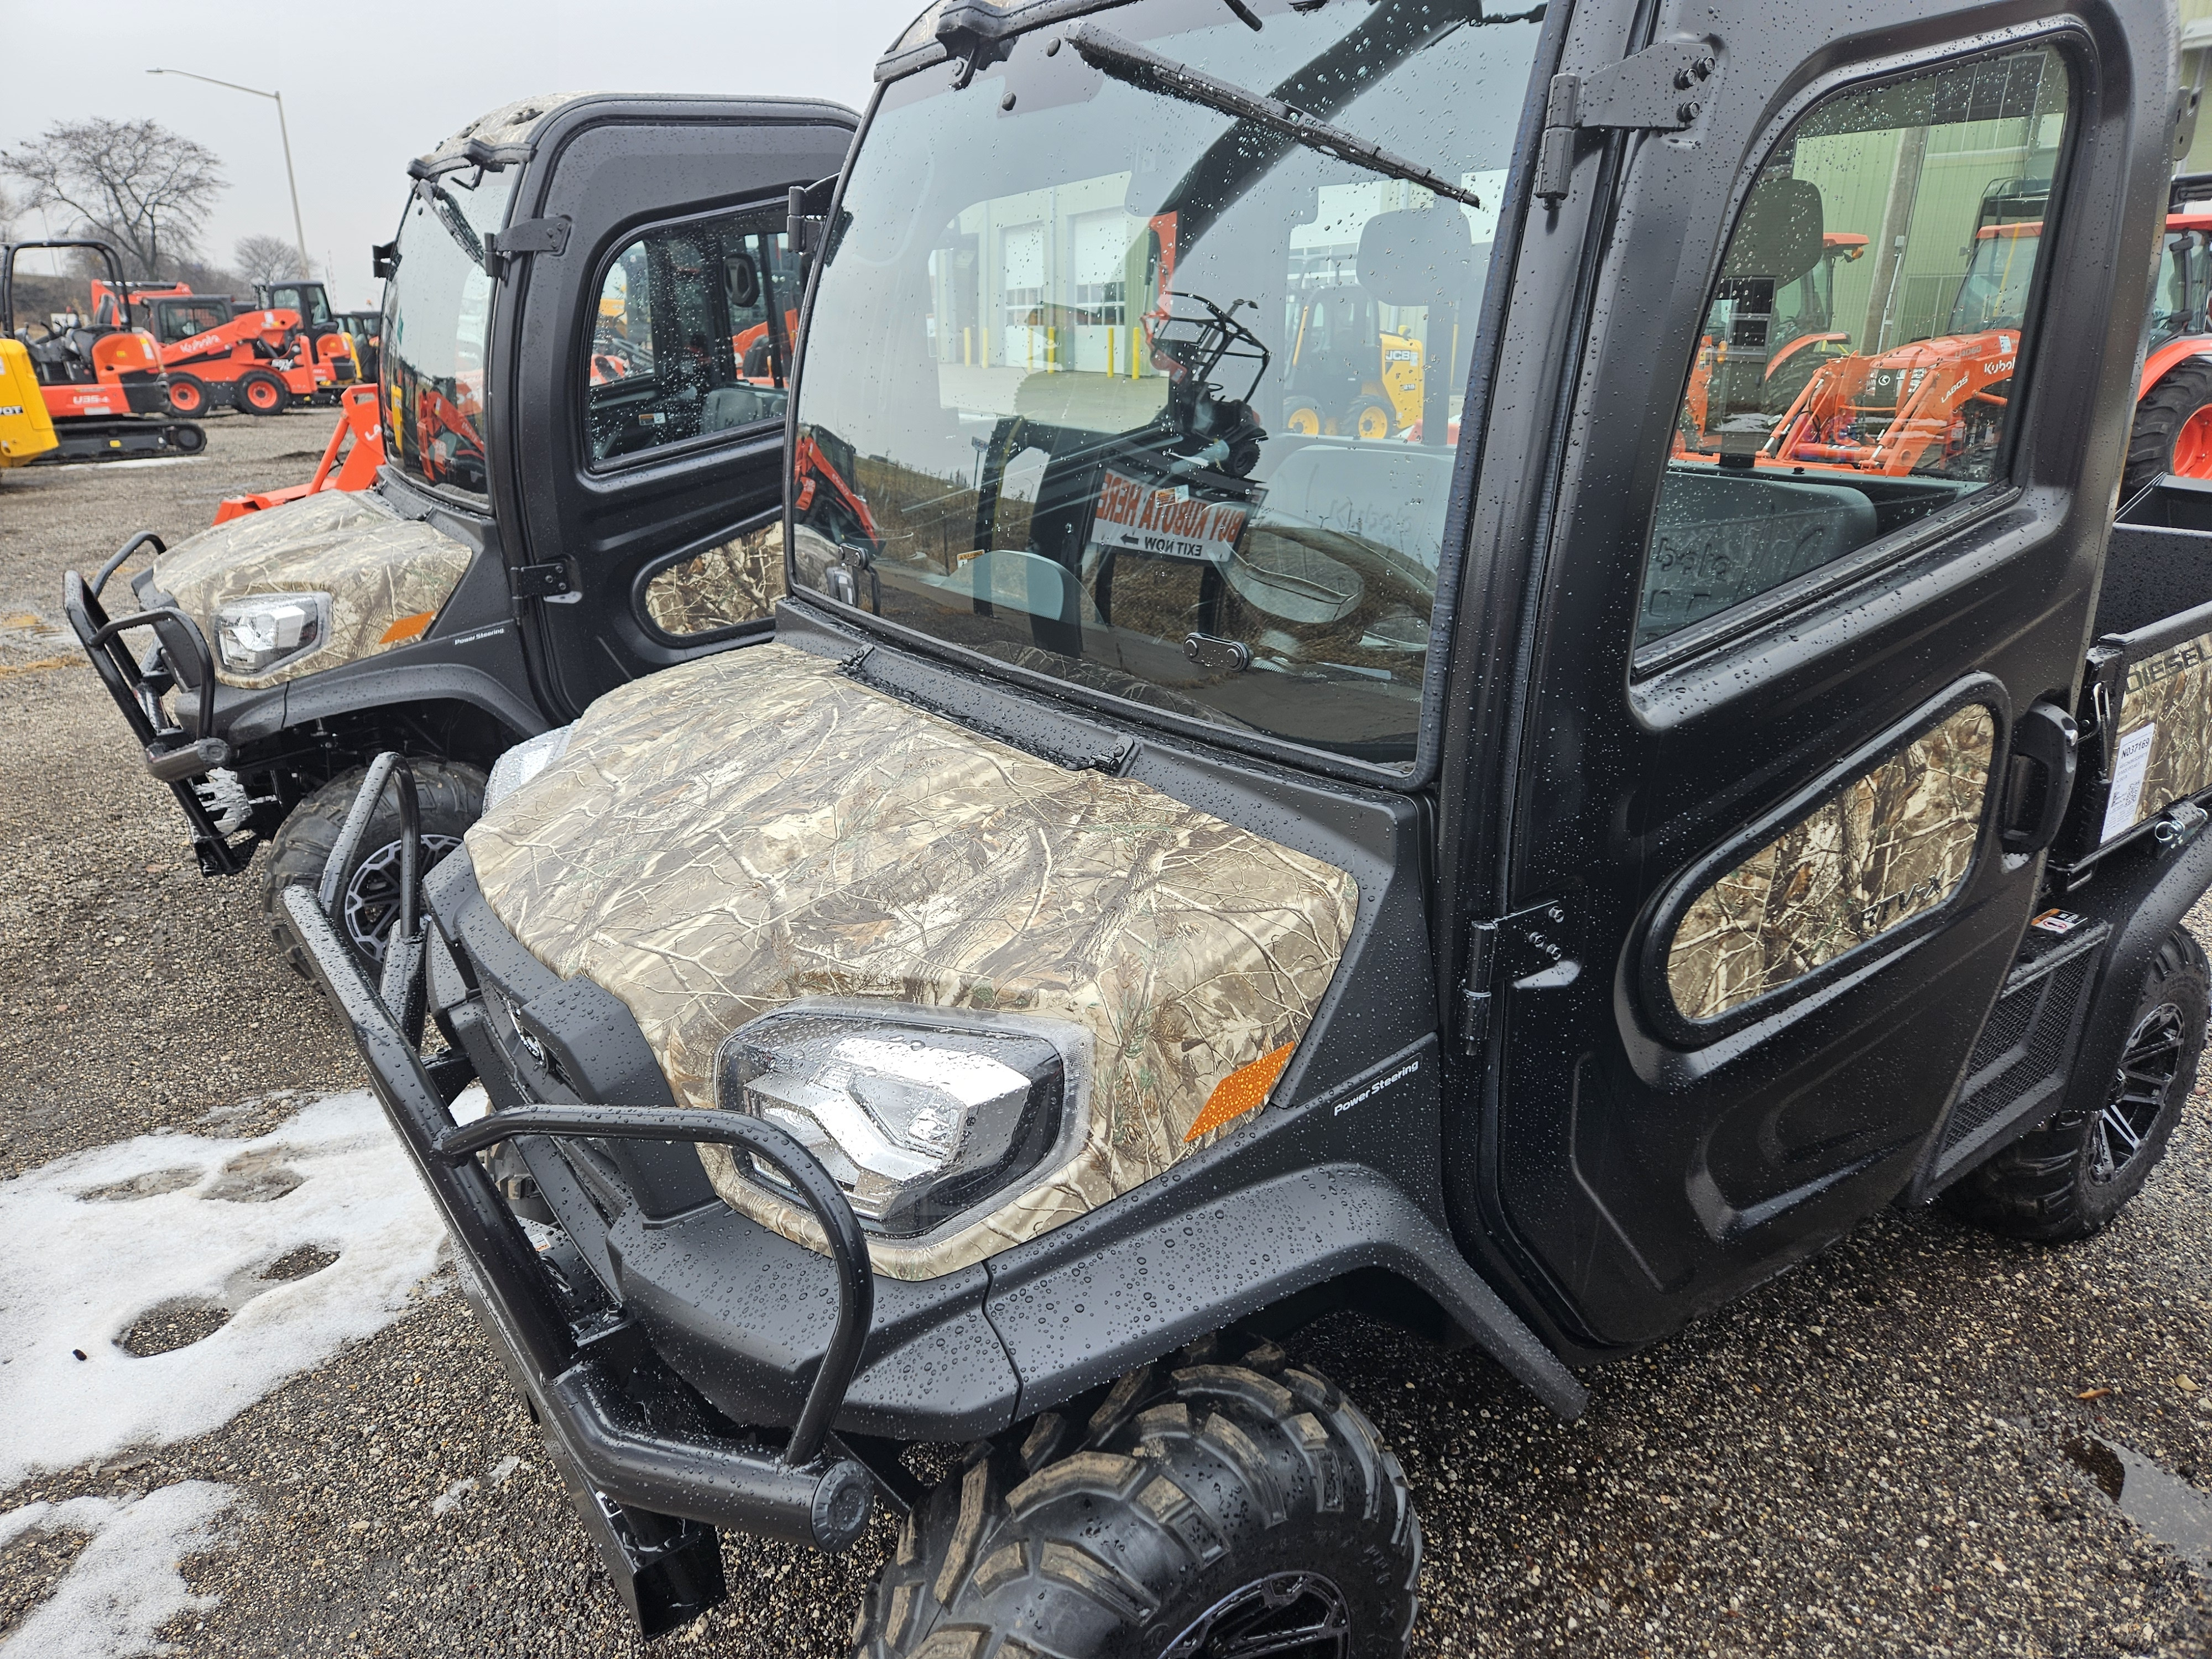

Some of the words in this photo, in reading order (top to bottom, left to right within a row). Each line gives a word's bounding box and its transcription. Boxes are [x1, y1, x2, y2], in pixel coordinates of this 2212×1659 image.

[1385, 349, 1410, 360] JCB
[1984, 357, 2016, 374] Kubot
[1941, 375, 1968, 403] LA805
[455, 635, 475, 645] Power
[476, 628, 504, 640] Steering
[2126, 640, 2212, 695] DIESEL
[1334, 1089, 1371, 1117] Power
[1371, 1061, 1419, 1095] Steering
